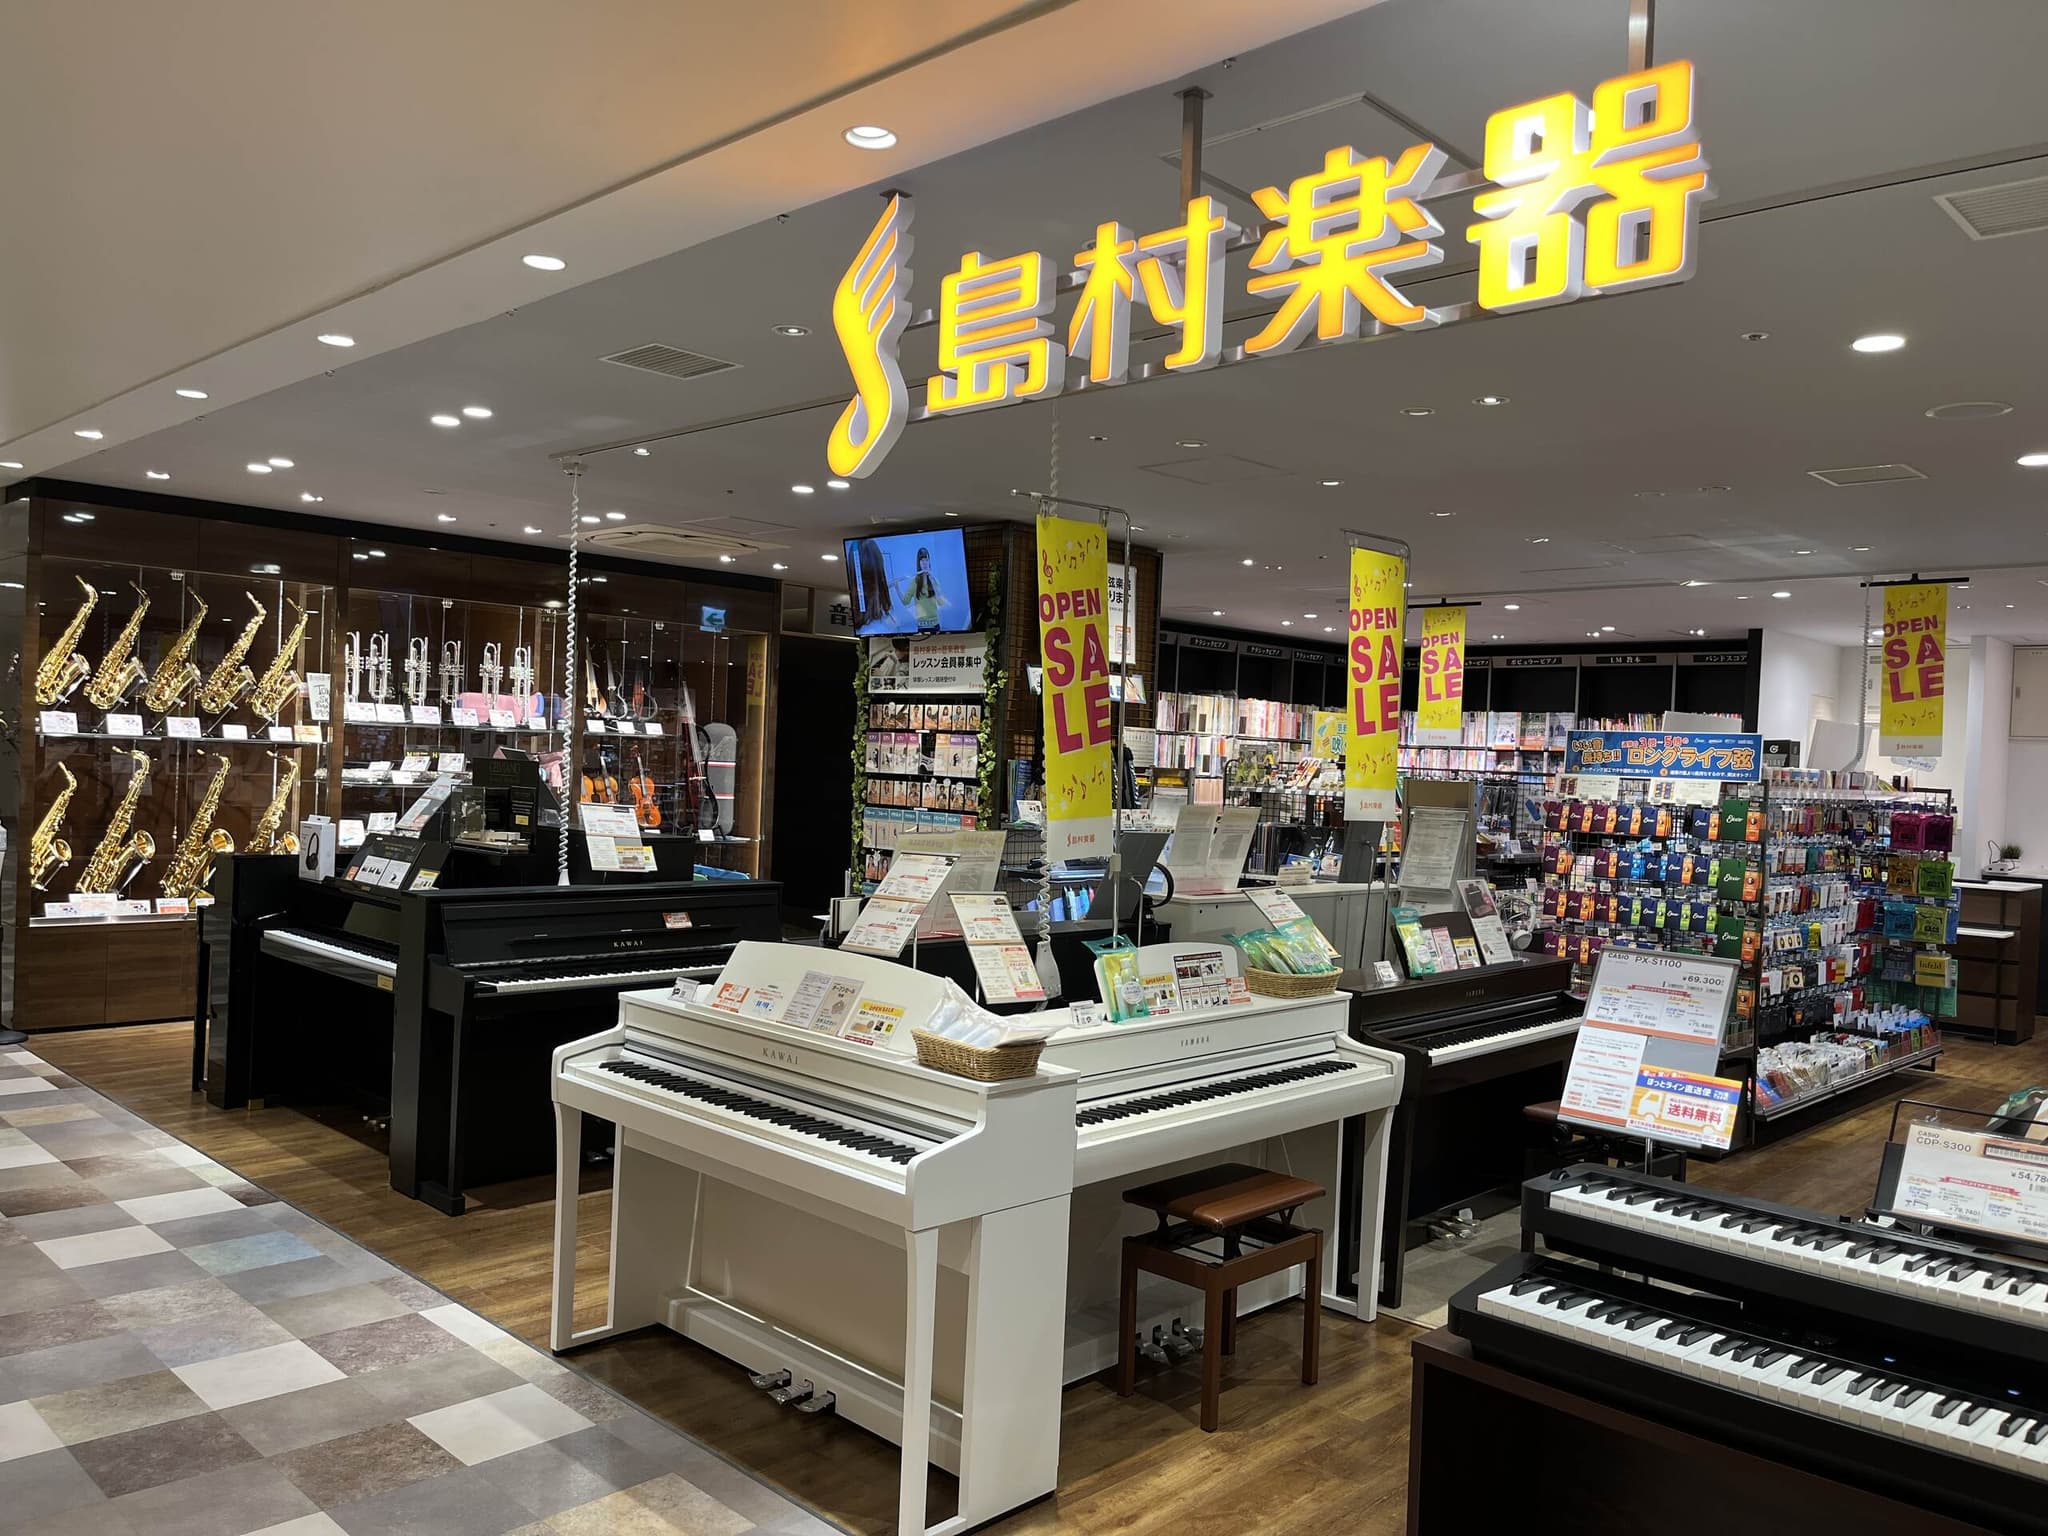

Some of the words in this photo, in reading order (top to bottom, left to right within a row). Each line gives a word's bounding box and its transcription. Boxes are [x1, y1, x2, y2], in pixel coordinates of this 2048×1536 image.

[926, 59, 1708, 413] 島村楽器
[1040, 588, 1101, 622] OPEN
[1350, 607, 1397, 631] OPEN
[1883, 615, 1938, 637] OPEN
[1421, 632, 1459, 648] OPEN
[913, 656, 982, 669] レッスン会員募集中
[1627, 747, 1755, 770] ロングライフ弦
[613, 940, 643, 948] KAWAI
[1608, 952, 1630, 961] CASIO
[1634, 956, 1682, 969] PX-S1100
[762, 1047, 799, 1065] KAWAI
[1667, 1103, 1722, 1125] 送料無料
[1917, 1130, 1940, 1139] CASIO
[1916, 1136, 1972, 1153] CDP-S300
